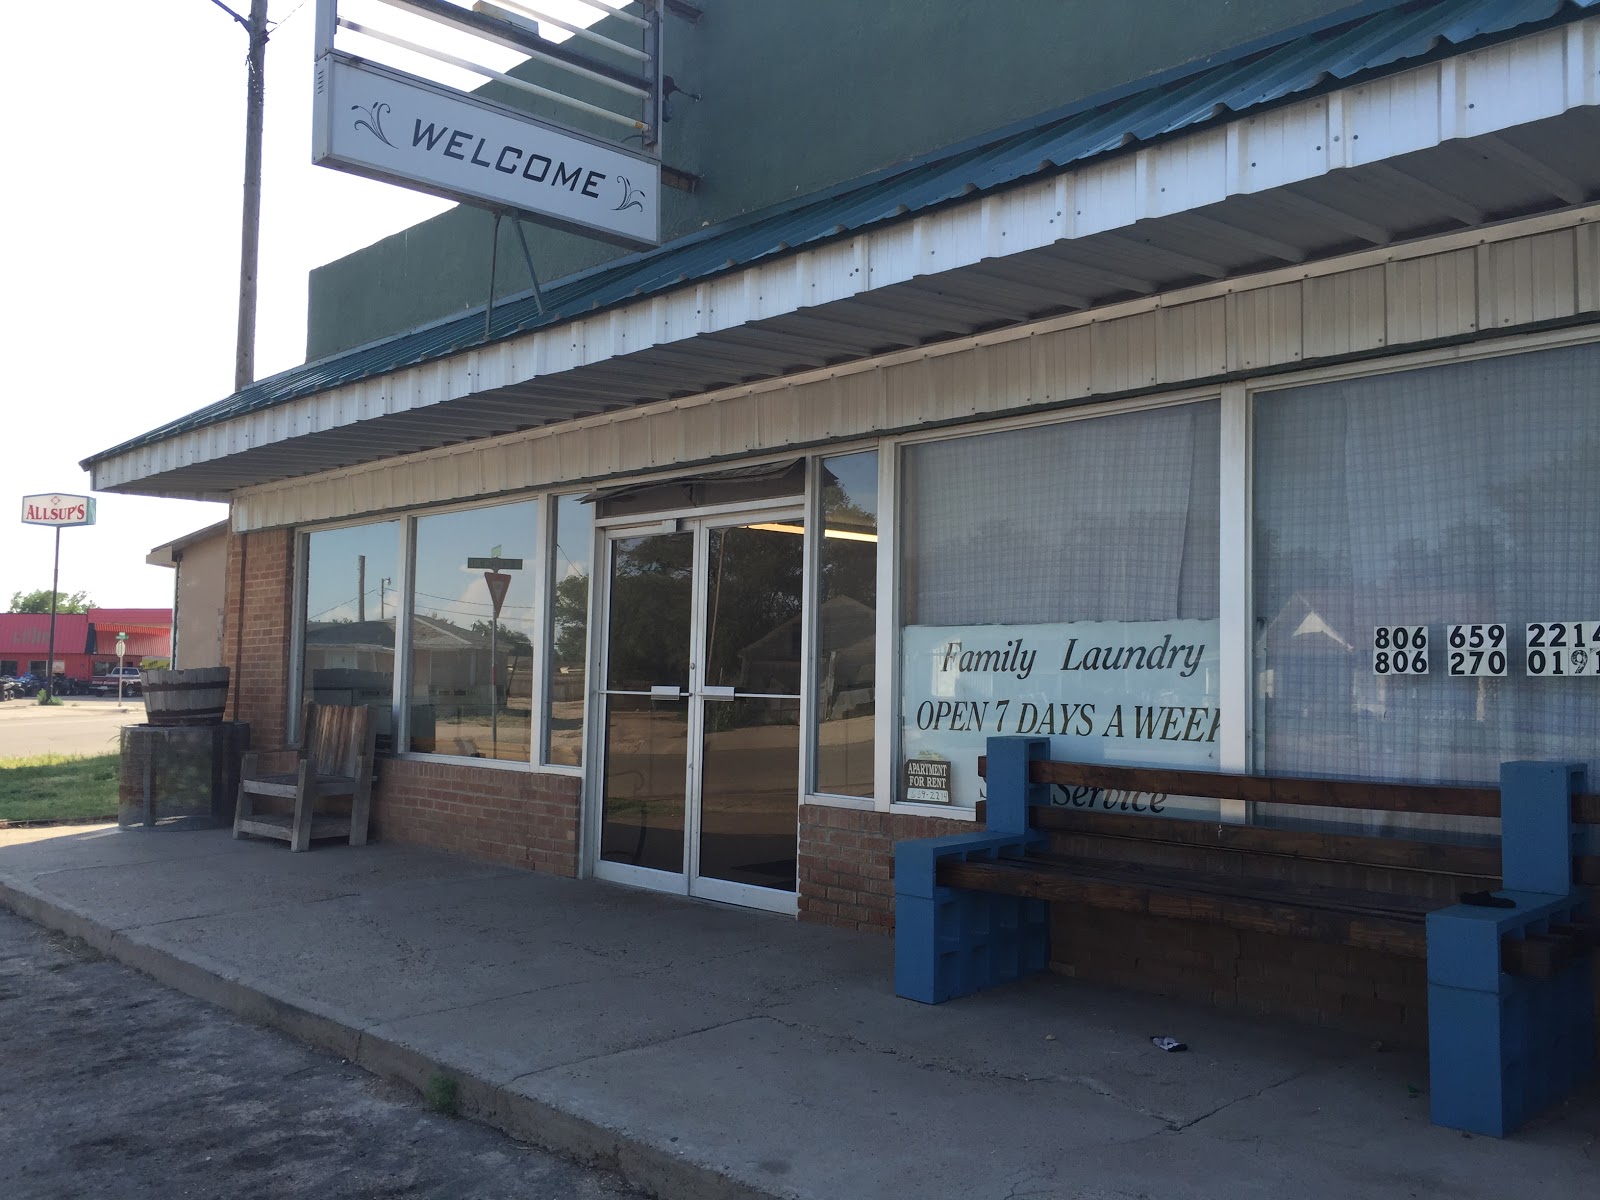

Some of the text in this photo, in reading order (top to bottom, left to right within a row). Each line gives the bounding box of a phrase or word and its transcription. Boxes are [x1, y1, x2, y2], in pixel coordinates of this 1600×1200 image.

[411, 118, 607, 199] WELCOME
[26, 504, 85, 520] ALLSUP'S
[1374, 626, 1427, 650] 806
[1449, 624, 1505, 649] 659
[940, 634, 1206, 680] Family Laundry
[1374, 650, 1428, 674] 806
[1450, 650, 1506, 675] 270
[916, 700, 989, 732] OPEN
[995, 699, 1010, 732] 7
[1015, 702, 1096, 737] DAYS
[1102, 704, 1124, 738] A
[908, 762, 947, 776] APARTMENT
[909, 776, 947, 788] FOR RENT
[1053, 783, 1168, 814] Service
